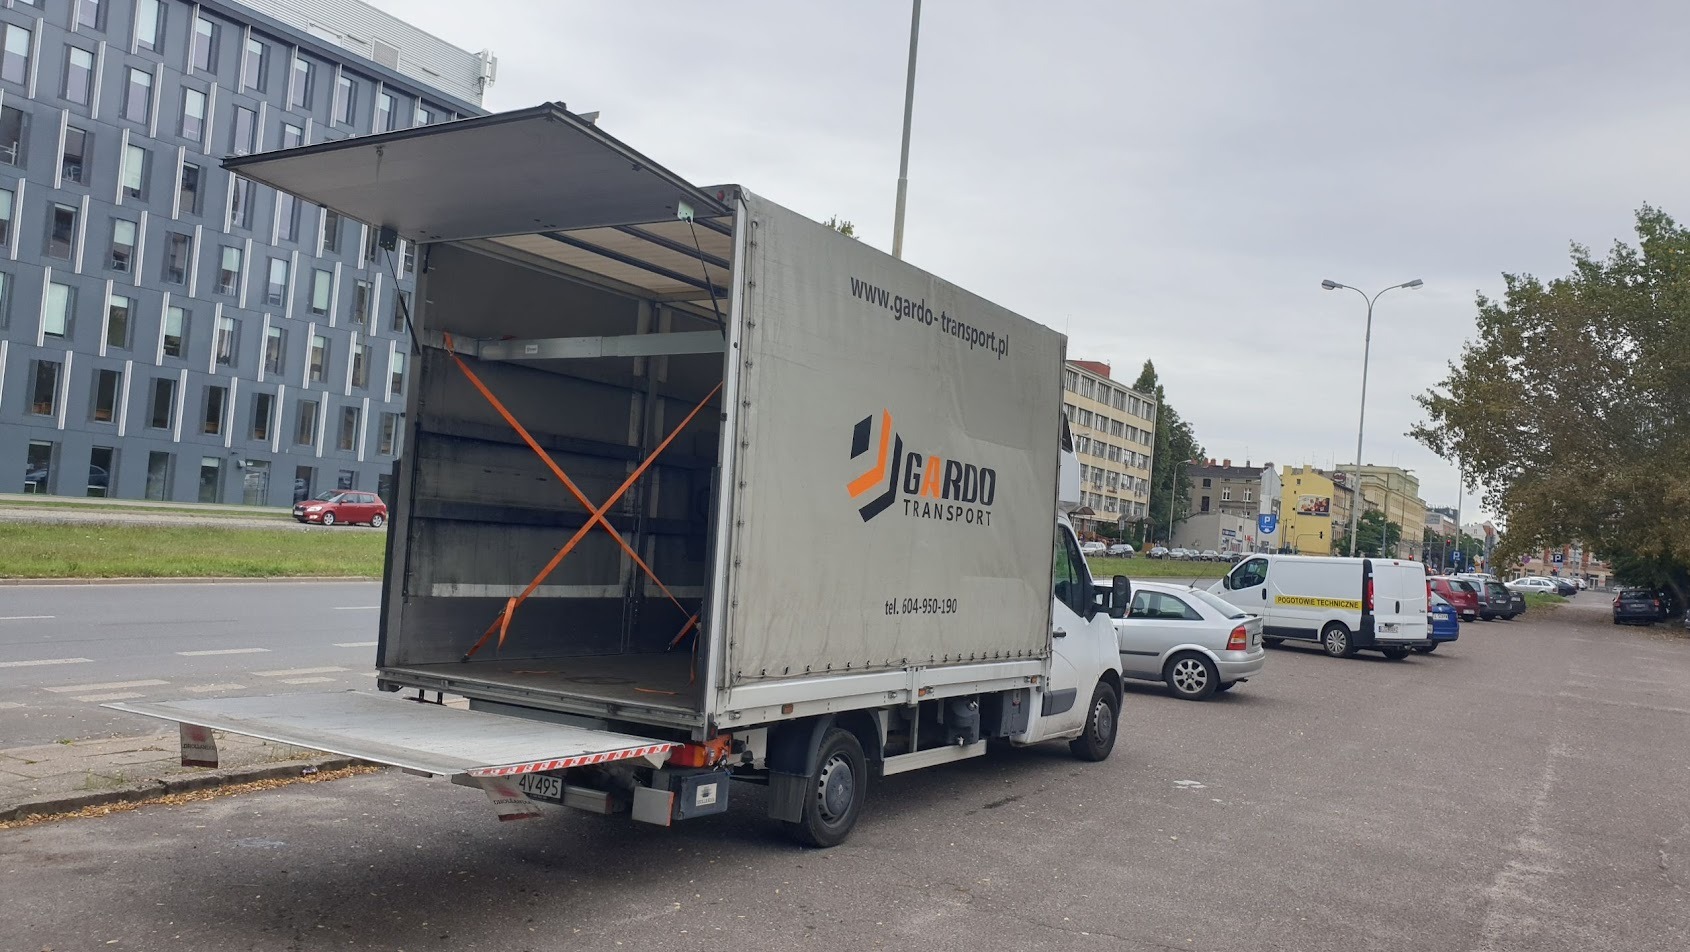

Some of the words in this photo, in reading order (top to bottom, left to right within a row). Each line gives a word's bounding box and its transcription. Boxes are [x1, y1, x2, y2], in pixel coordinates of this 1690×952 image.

[851, 277, 1009, 360] www.gardo-transport.pl
[903, 452, 996, 506] GARDO
[903, 499, 992, 526] TRANSPORT
[884, 597, 899, 615] tel.
[902, 598, 957, 614] 604-950-190
[1277, 596, 1315, 605] POGOTOWIE
[1317, 599, 1359, 609] TECHNICZNE
[519, 774, 559, 796] 4V495
